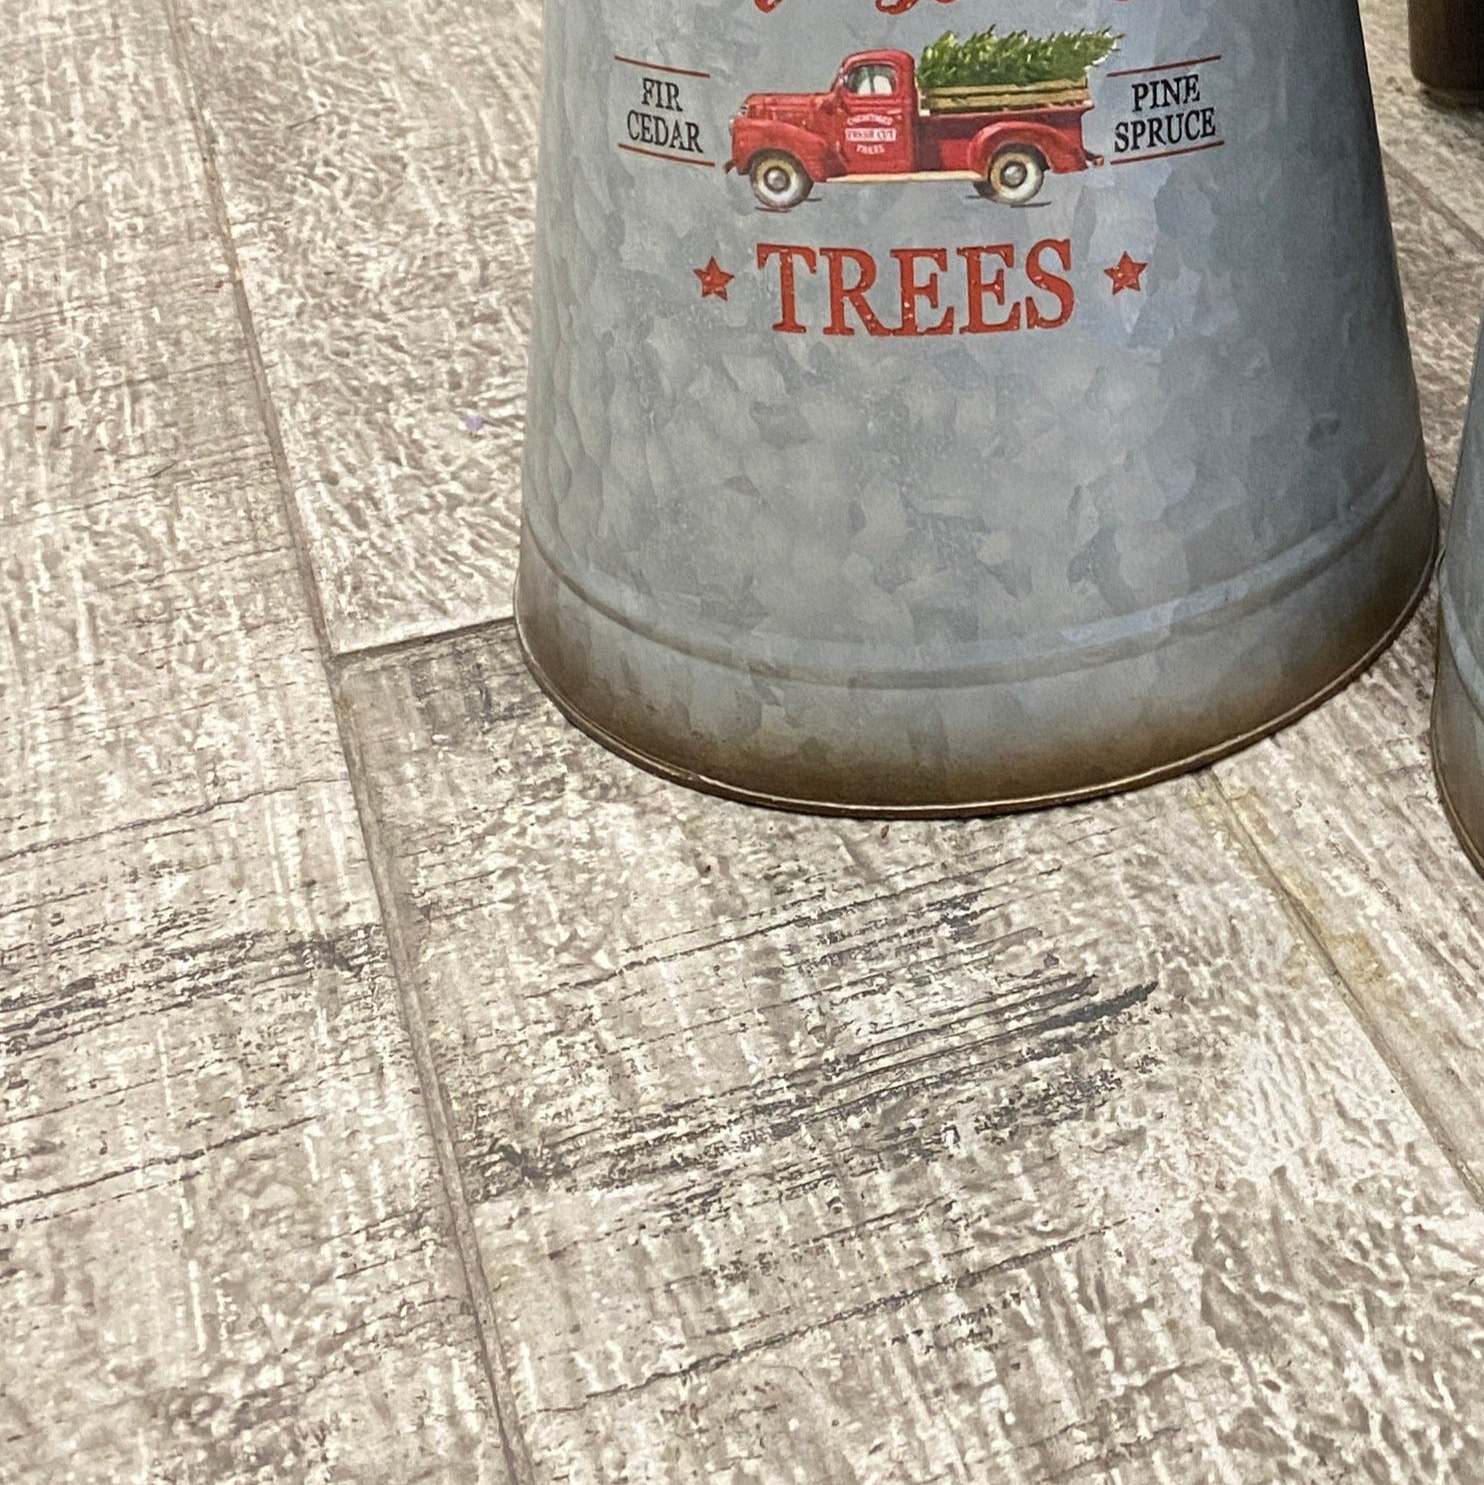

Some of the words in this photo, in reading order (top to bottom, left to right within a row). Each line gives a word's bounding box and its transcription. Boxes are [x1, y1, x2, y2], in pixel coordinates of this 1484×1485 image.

[642, 77, 684, 114] FIR
[1131, 73, 1201, 111] PINE
[626, 109, 704, 154] CEDAR
[1113, 107, 1216, 154] SPRUCE
[755, 237, 1075, 338] TREES
